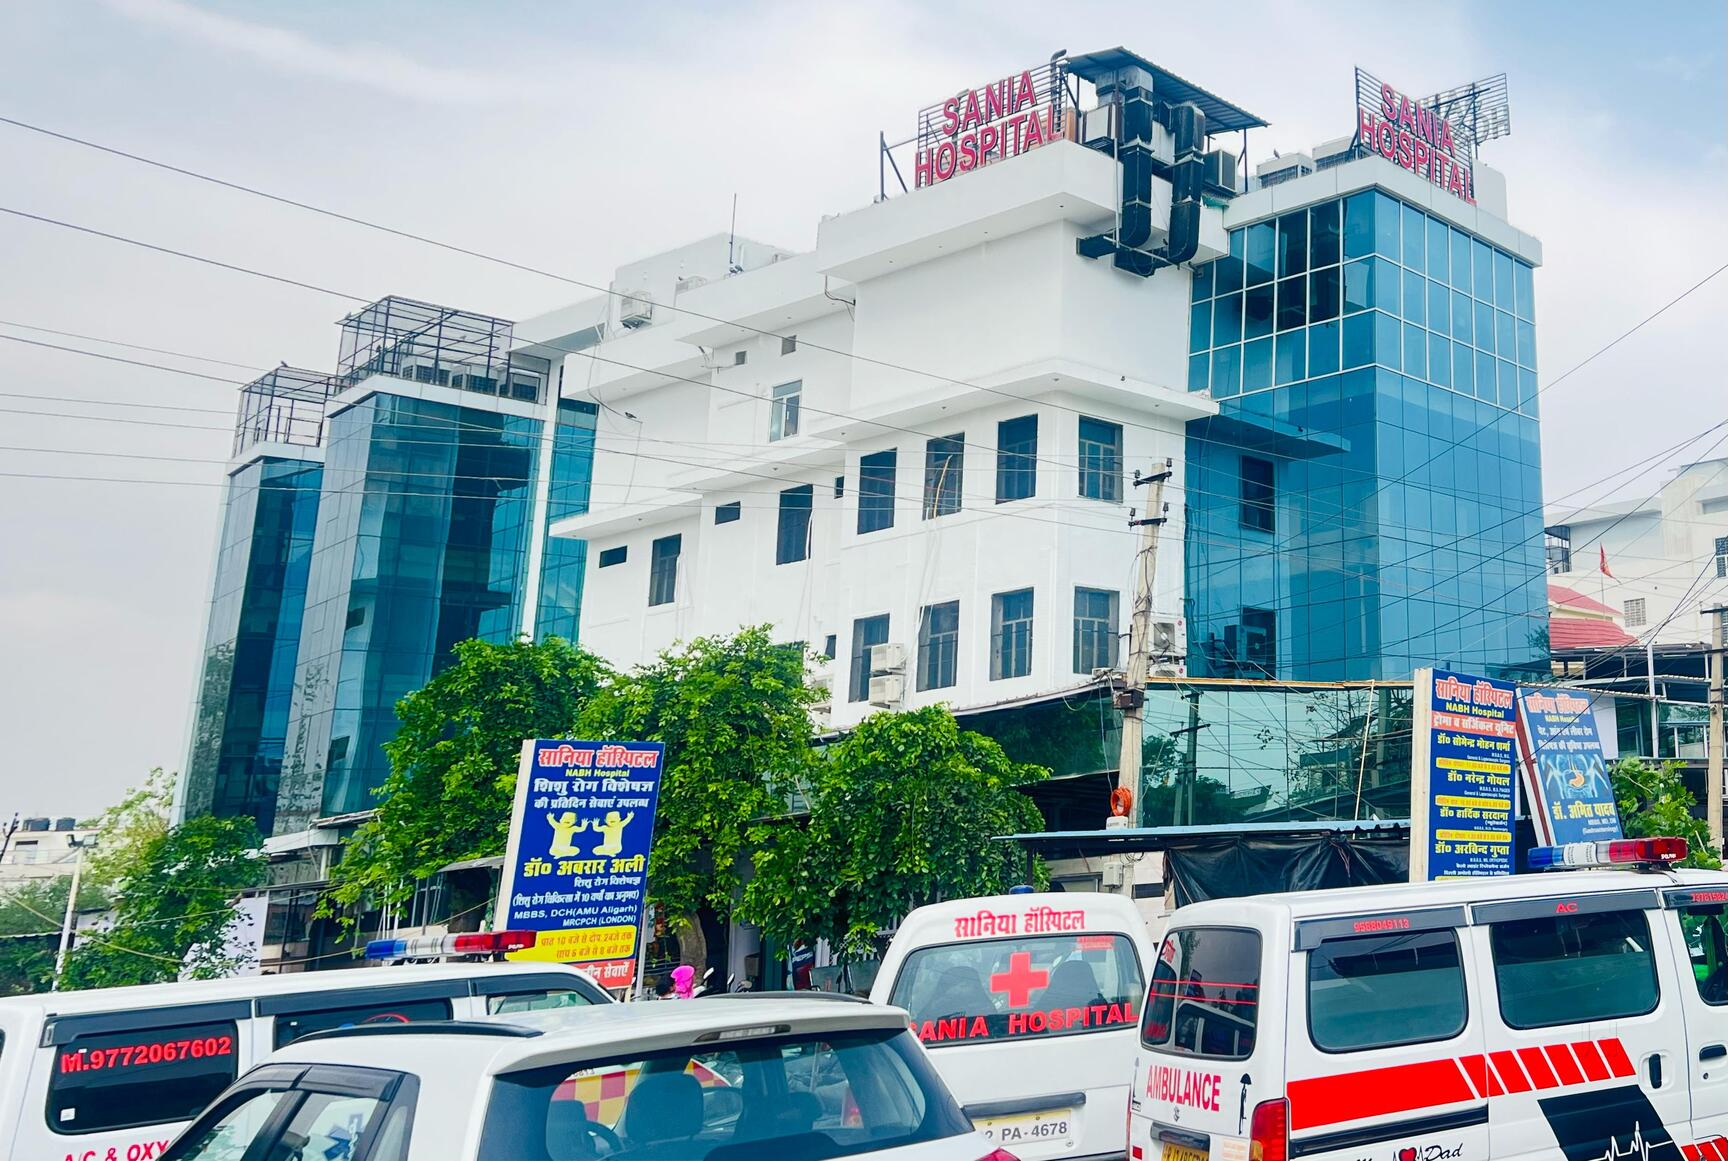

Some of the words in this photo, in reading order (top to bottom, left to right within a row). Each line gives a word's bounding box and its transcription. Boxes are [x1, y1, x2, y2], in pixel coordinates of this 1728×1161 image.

[942, 70, 1037, 136] SANIA
[1381, 83, 1455, 158] SANIA
[915, 104, 1065, 188] HOSPITAL
[1359, 108, 1477, 206] HOSPITAL
[1435, 676, 1472, 703] सानिया
[1473, 680, 1513, 709] हॉस्पिटल
[1446, 702, 1470, 713] NABH
[1472, 706, 1504, 718] Hospital
[538, 745, 594, 768] सानिया
[595, 745, 659, 768] हॉस्पिटल
[565, 769, 592, 777] NABH
[594, 769, 629, 778] Hospital
[1486, 774, 1510, 786] गोयल
[533, 778, 568, 796] शिशु
[572, 778, 599, 792] रोग
[534, 798, 548, 809] की
[550, 797, 587, 809] प्रतिदिन
[1568, 800, 1593, 818] अमित
[1593, 803, 1615, 816] यादव
[1489, 845, 1510, 858] गुप्ता
[609, 855, 646, 873] अली
[594, 876, 608, 886] रोग
[581, 892, 591, 902] 10
[513, 909, 549, 919] MBBS,
[549, 907, 599, 917] DCH(AMU
[600, 904, 638, 916] Aligarh)
[1556, 902, 1578, 913] AC
[562, 916, 597, 927] MRCPCH
[598, 915, 637, 925] (LONDON)
[953, 910, 1018, 938] सानिया
[1023, 906, 1086, 933] हॉस्पिटल
[1009, 1002, 1139, 1034] HOSPITAL
[60, 1035, 232, 1073] M.9772067602
[1146, 1064, 1221, 1112] AMBULANCE
[105, 1147, 118, 1161] &
